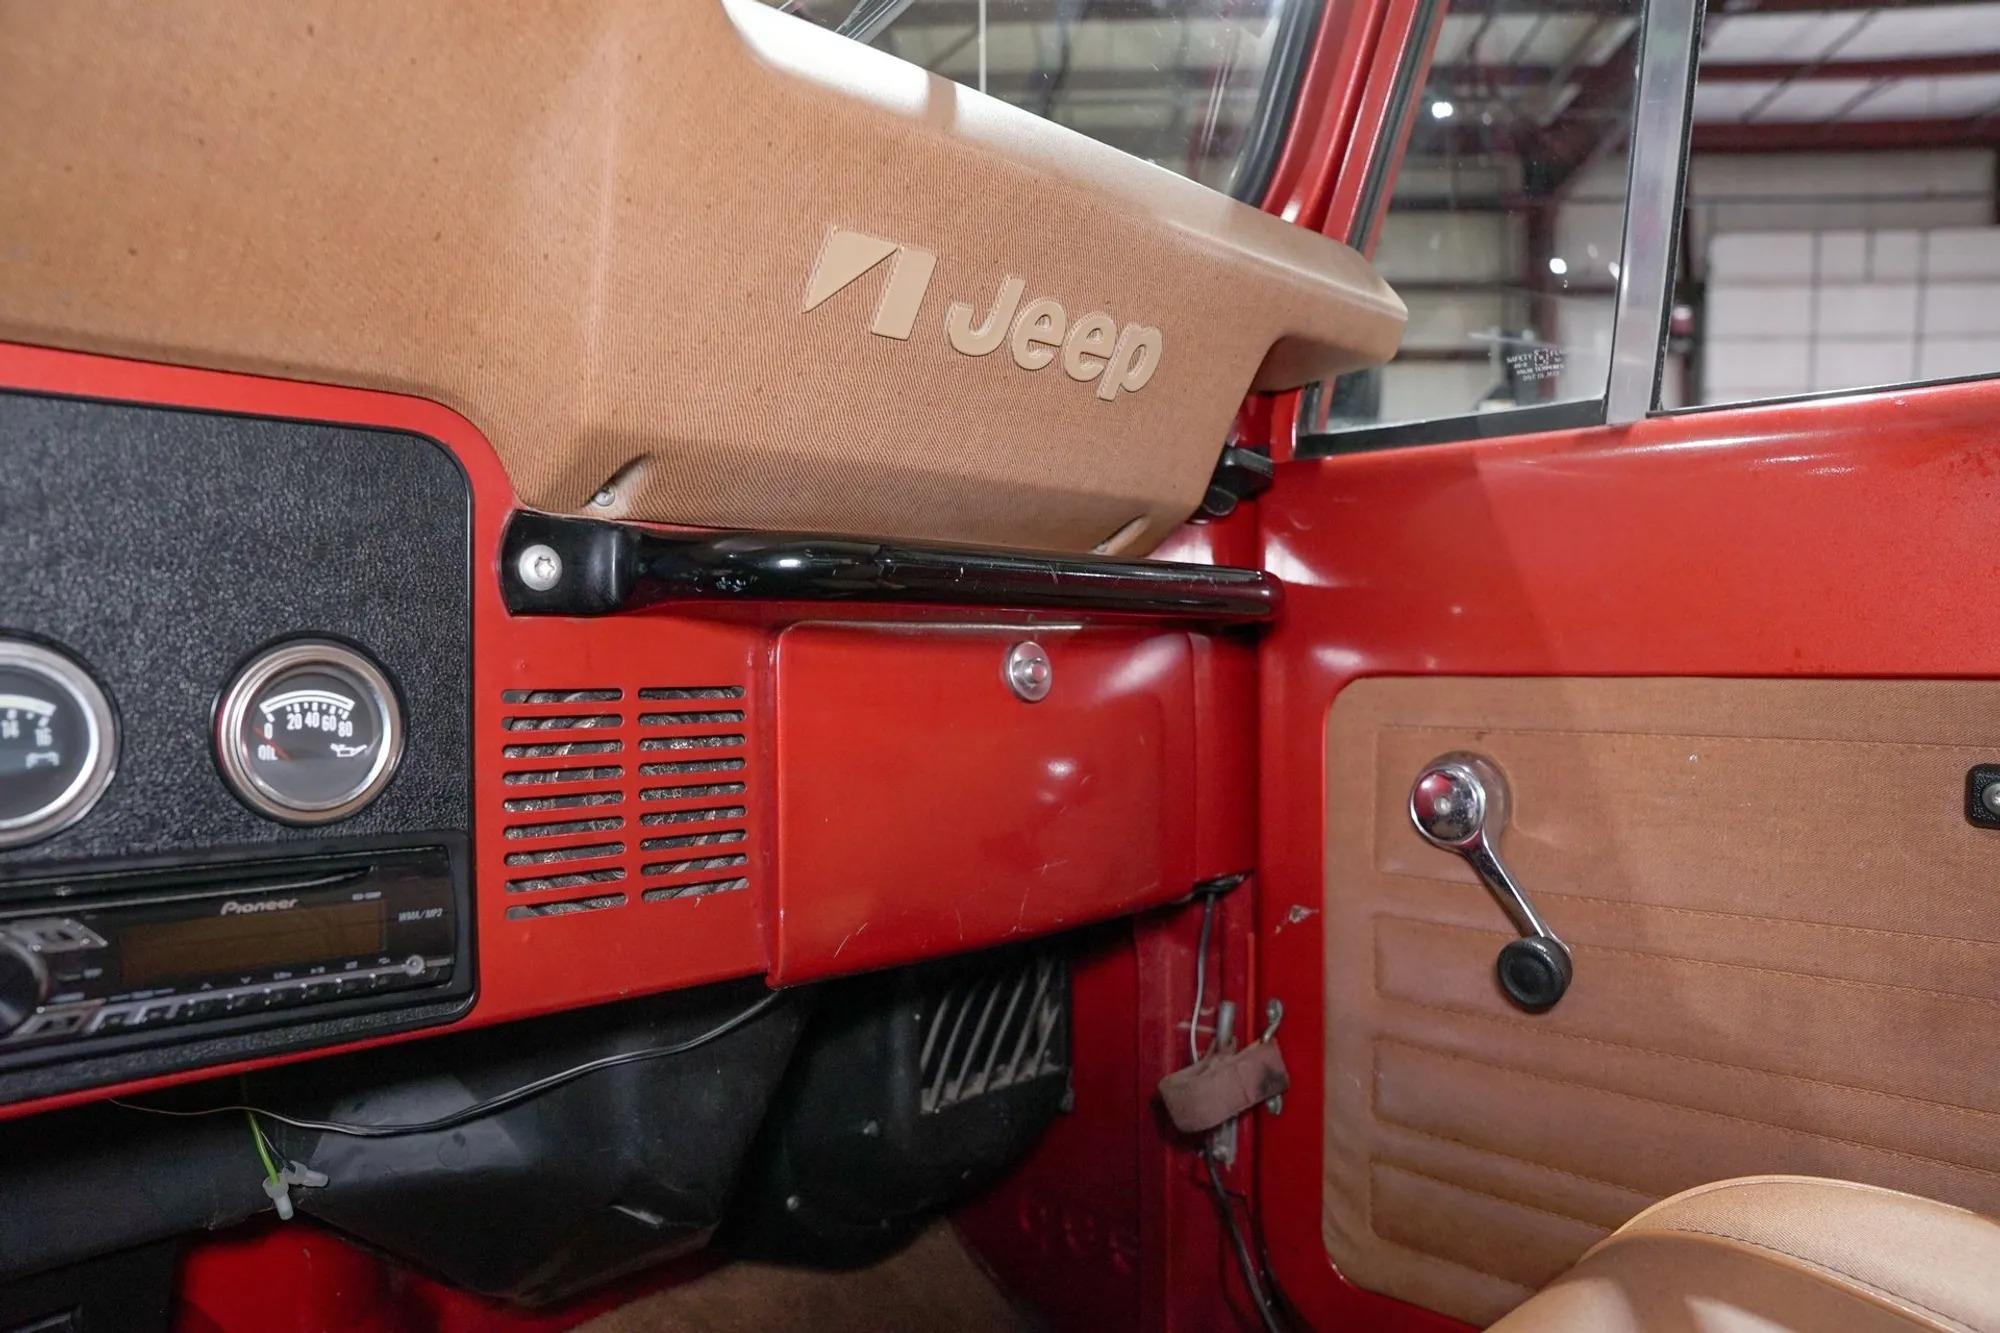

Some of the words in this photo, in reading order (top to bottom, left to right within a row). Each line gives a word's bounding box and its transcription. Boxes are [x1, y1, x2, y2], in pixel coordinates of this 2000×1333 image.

[945, 273, 1163, 401] Jeep
[263, 722, 273, 740] 0
[286, 713, 303, 730] 20
[304, 711, 320, 728] 40
[321, 714, 337, 731] 60
[338, 720, 353, 738] 80
[35, 727, 53, 747] 16
[257, 744, 278, 760] OIL
[220, 898, 298, 917] Pioneer
[398, 908, 443, 922] WMA/MP3
